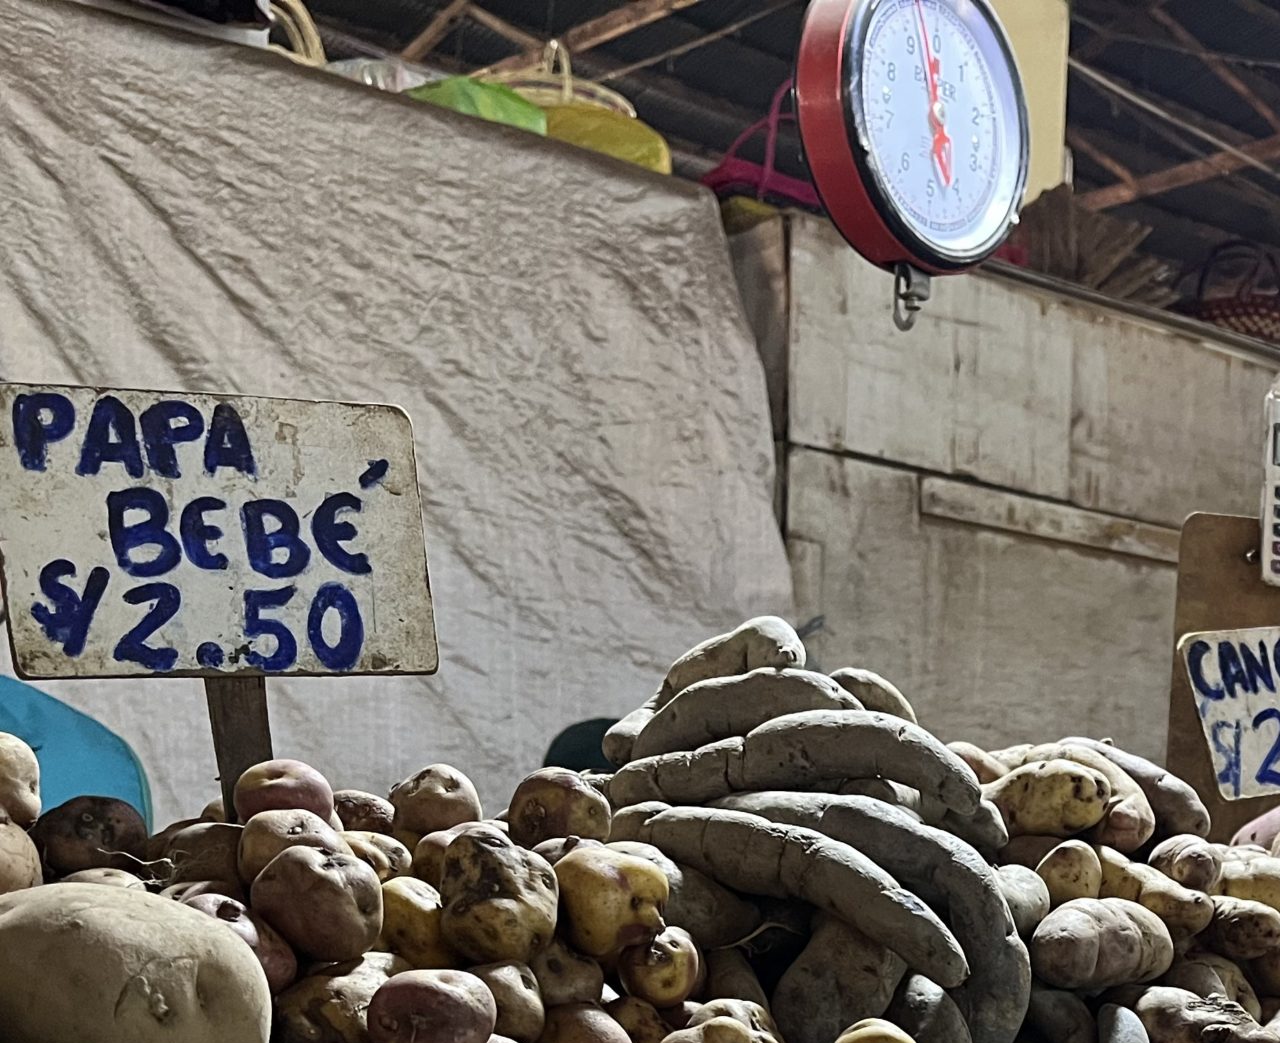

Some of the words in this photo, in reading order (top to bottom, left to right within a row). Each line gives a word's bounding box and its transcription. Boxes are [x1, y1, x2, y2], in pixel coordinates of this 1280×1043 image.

[907, 35, 915, 55] 9
[933, 34, 941, 51] 0
[887, 62, 896, 82] 8
[958, 64, 964, 82] 1
[886, 110, 895, 130] 7
[972, 107, 980, 126] 2
[901, 152, 910, 172] 6
[969, 153, 978, 172] 3
[926, 178, 935, 198] 5
[951, 178, 960, 197] 4
[13, 393, 259, 479] PAPA
[106, 459, 389, 578] BEBÉ
